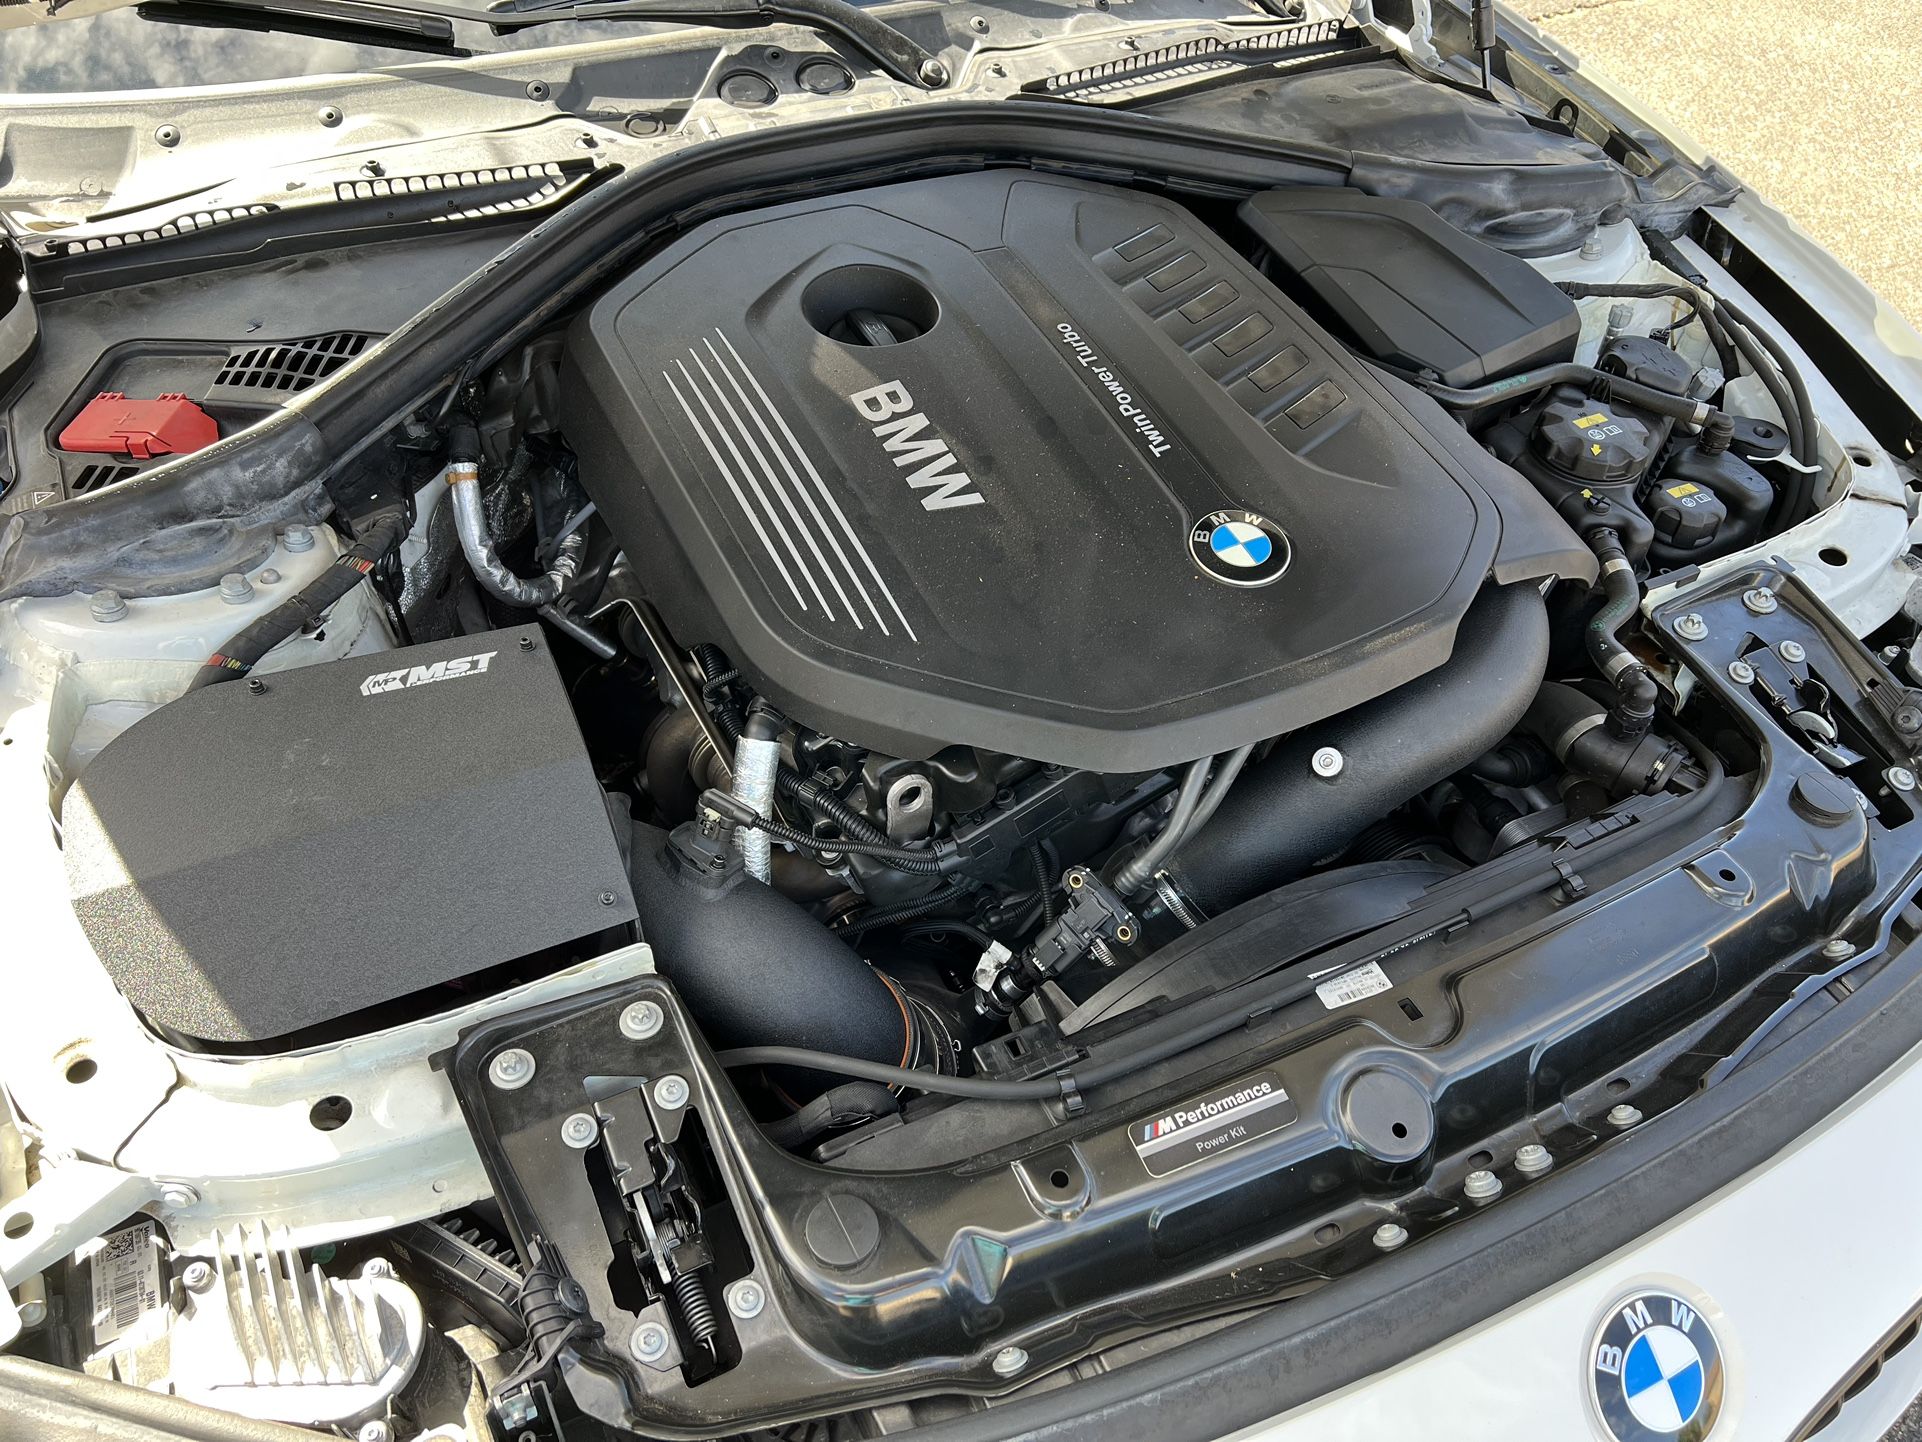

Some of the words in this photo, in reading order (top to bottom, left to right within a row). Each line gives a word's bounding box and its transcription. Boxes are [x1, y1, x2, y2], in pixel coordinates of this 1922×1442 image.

[1056, 322, 1098, 367] Turbo
[1092, 366, 1172, 458] TwinPower
[850, 379, 986, 511] BMW
[1193, 512, 1263, 543] BMW
[405, 650, 498, 688] MST
[1173, 1081, 1272, 1128] Performance
[1195, 1132, 1230, 1153] Power
[1230, 1125, 1247, 1140] Kit
[145, 1289, 157, 1310] BMW
[1596, 1298, 1696, 1377] BMW
